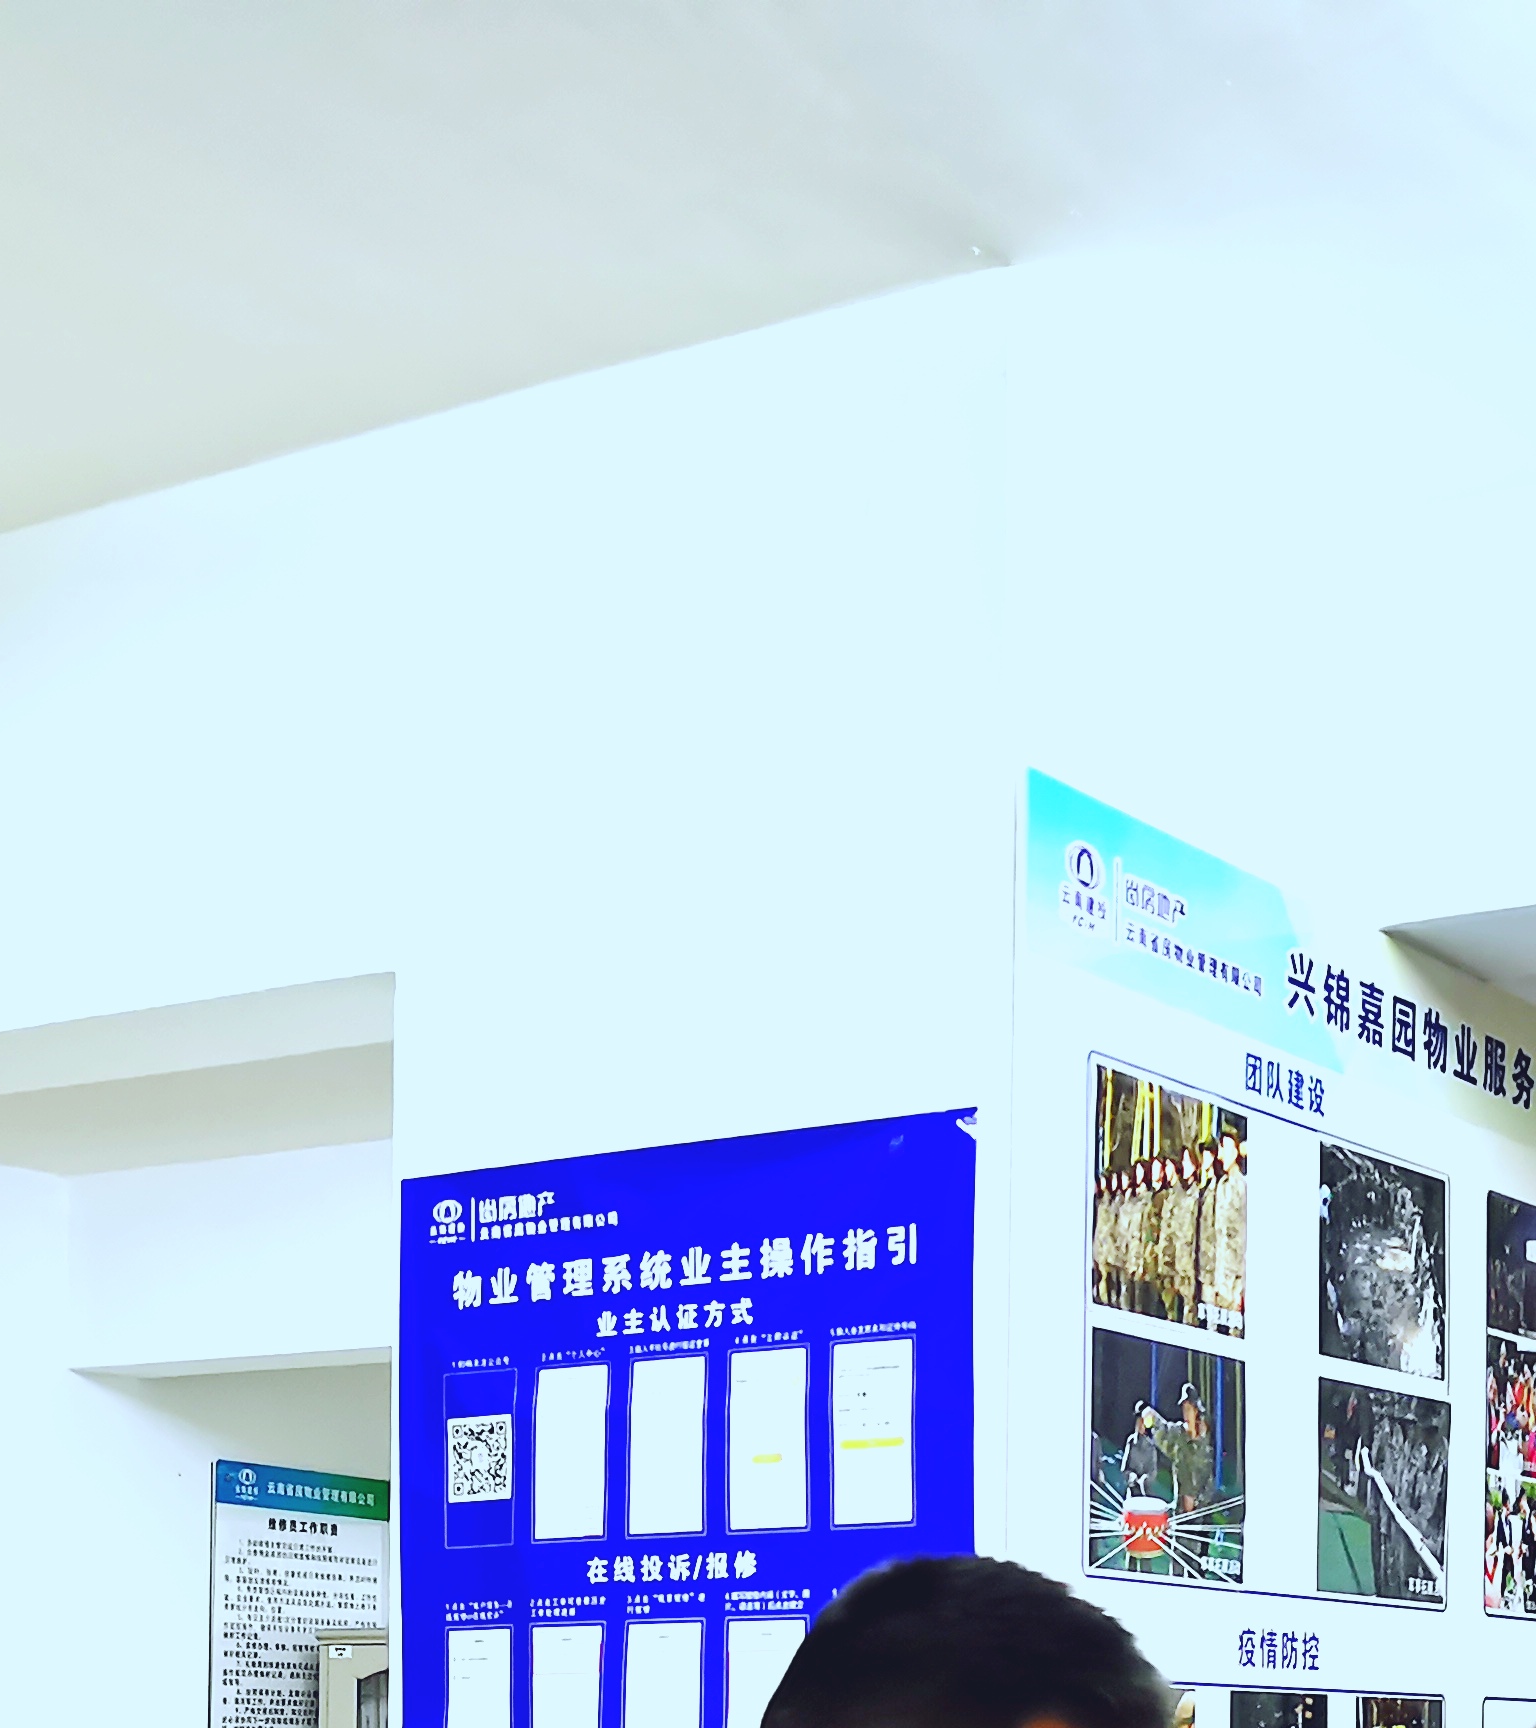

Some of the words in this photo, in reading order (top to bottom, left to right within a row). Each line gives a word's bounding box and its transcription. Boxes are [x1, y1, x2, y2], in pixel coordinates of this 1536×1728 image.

[1245, 1052, 1325, 1117] 团队建设
[452, 1222, 919, 1310] 物业管理系统业主操作指引
[595, 1296, 754, 1338] 业主认证方式
[586, 1550, 758, 1585] 在线投诉/报修
[1238, 1627, 1320, 1671] 疫情防控
